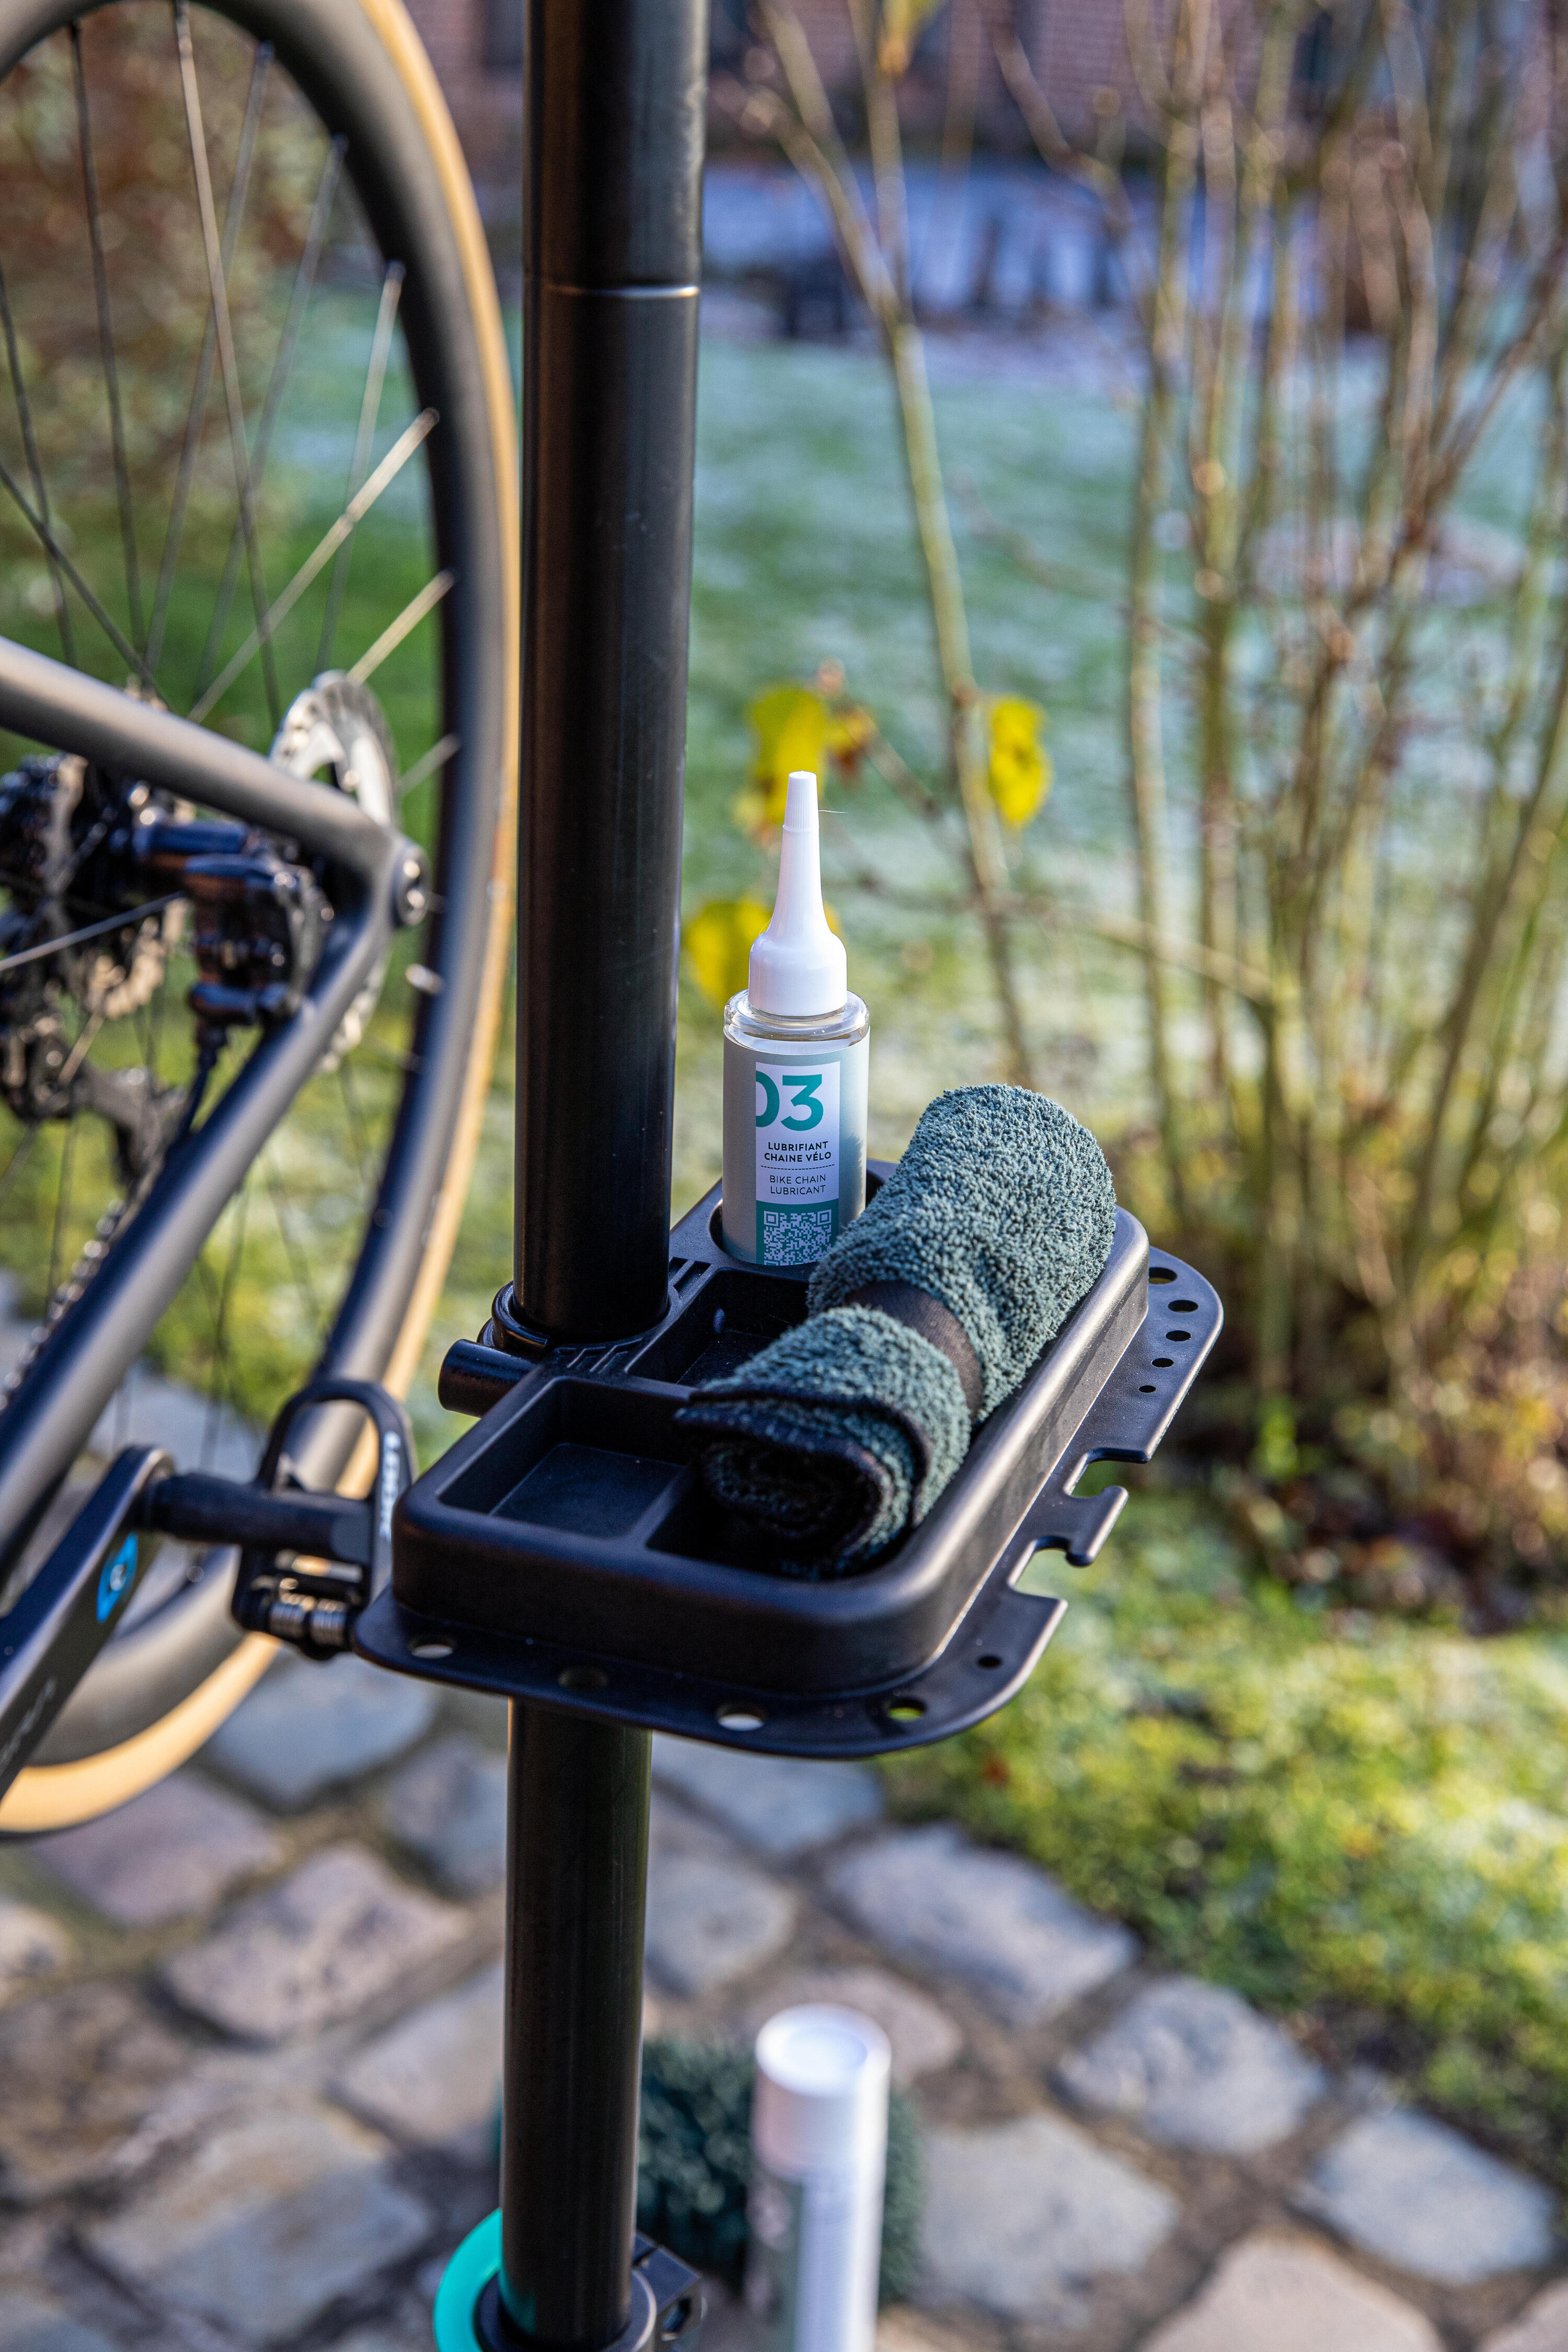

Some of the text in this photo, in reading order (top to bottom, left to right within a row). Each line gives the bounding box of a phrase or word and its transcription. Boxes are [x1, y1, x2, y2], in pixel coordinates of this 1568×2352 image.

[768, 1141, 828, 1151] LUBRIFIANT
[764, 1151, 831, 1162] CHAINE VÉLO
[770, 1174, 826, 1184] BIKE CHAIN
[770, 1184, 826, 1195] LUBRICANT
